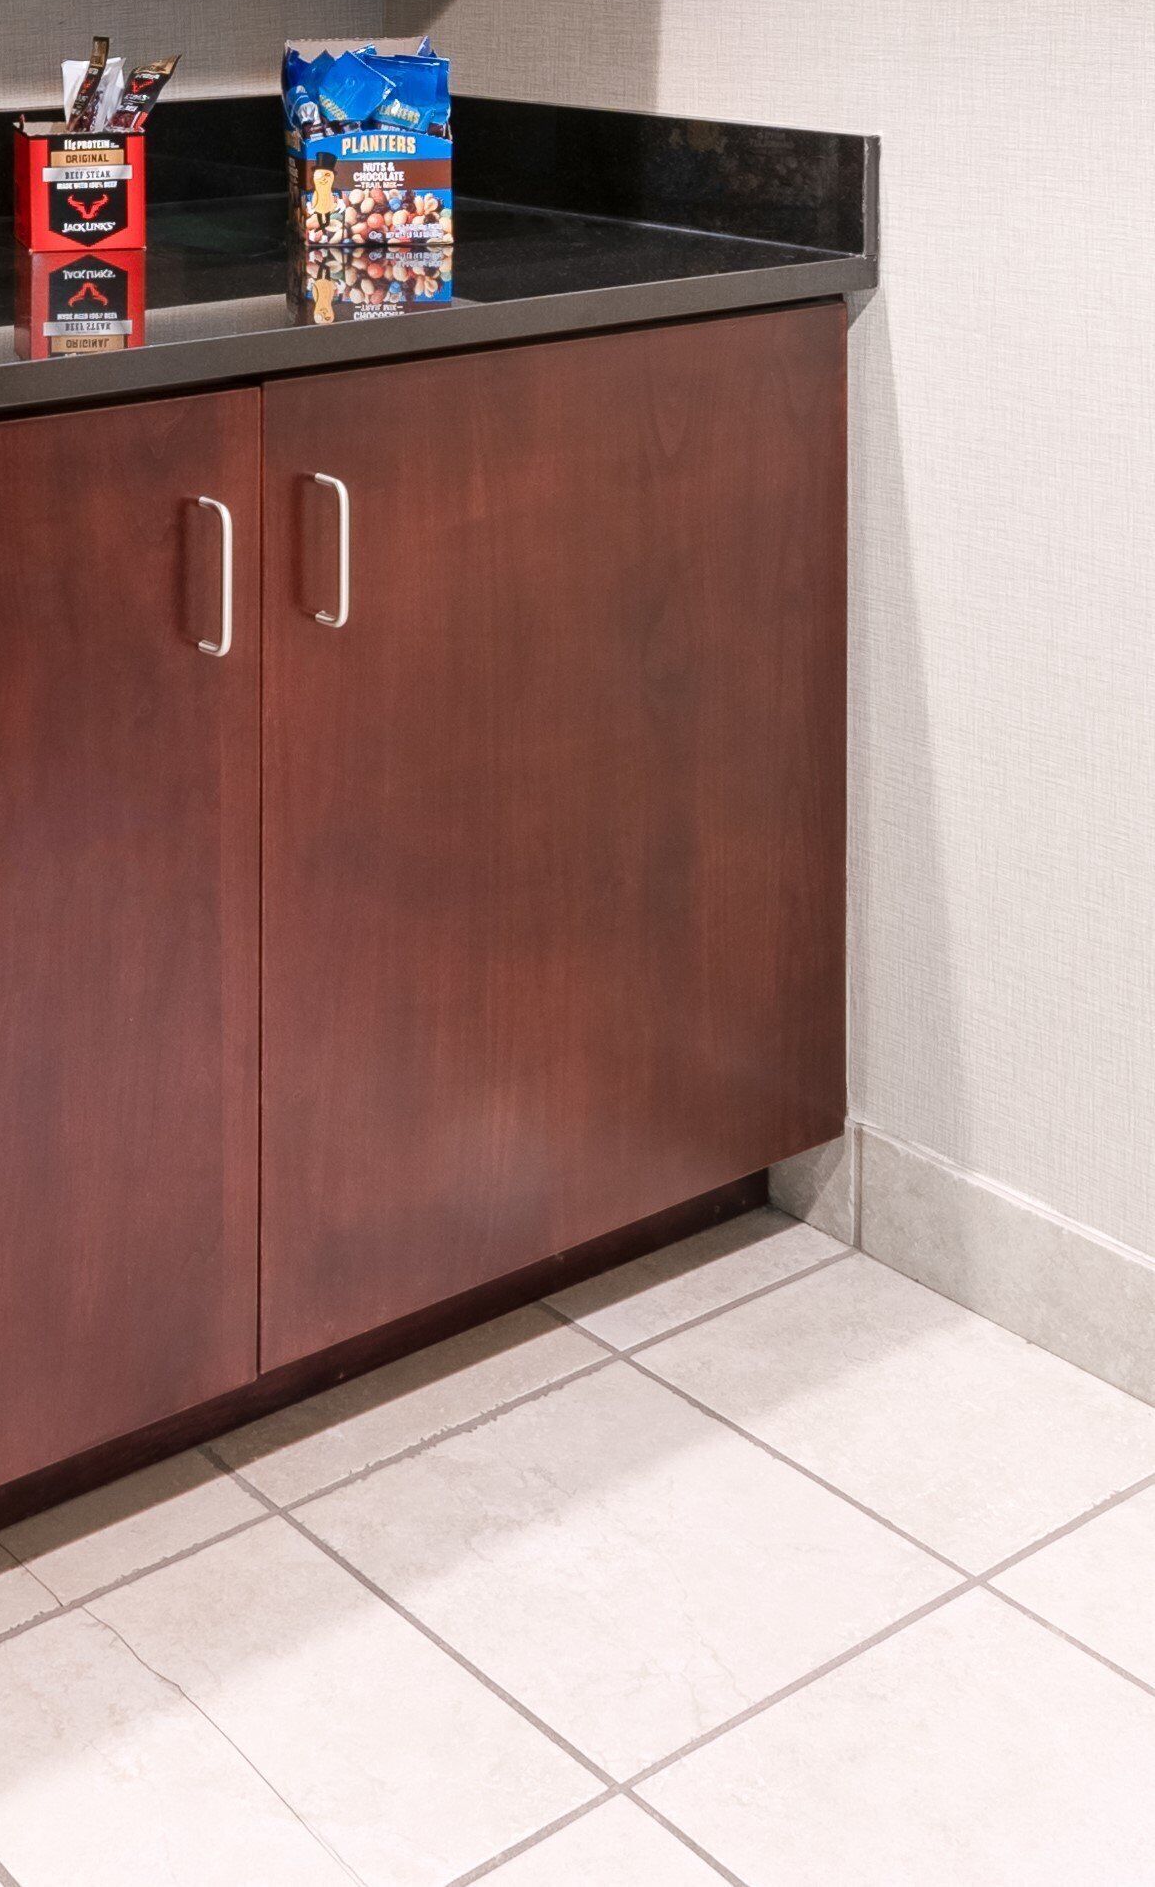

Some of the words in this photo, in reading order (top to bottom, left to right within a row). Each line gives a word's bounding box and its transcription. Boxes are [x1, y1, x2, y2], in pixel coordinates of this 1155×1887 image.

[76, 139, 111, 150] PROTEIN
[342, 134, 417, 156] PLANTERS
[65, 154, 110, 164] ORIGINAL
[362, 162, 387, 173] NUTS
[387, 162, 396, 172] &
[64, 171, 85, 180] BEEF
[85, 170, 112, 180] STEAK
[352, 170, 405, 182] CHOCOLATE
[61, 222, 86, 233] JACK
